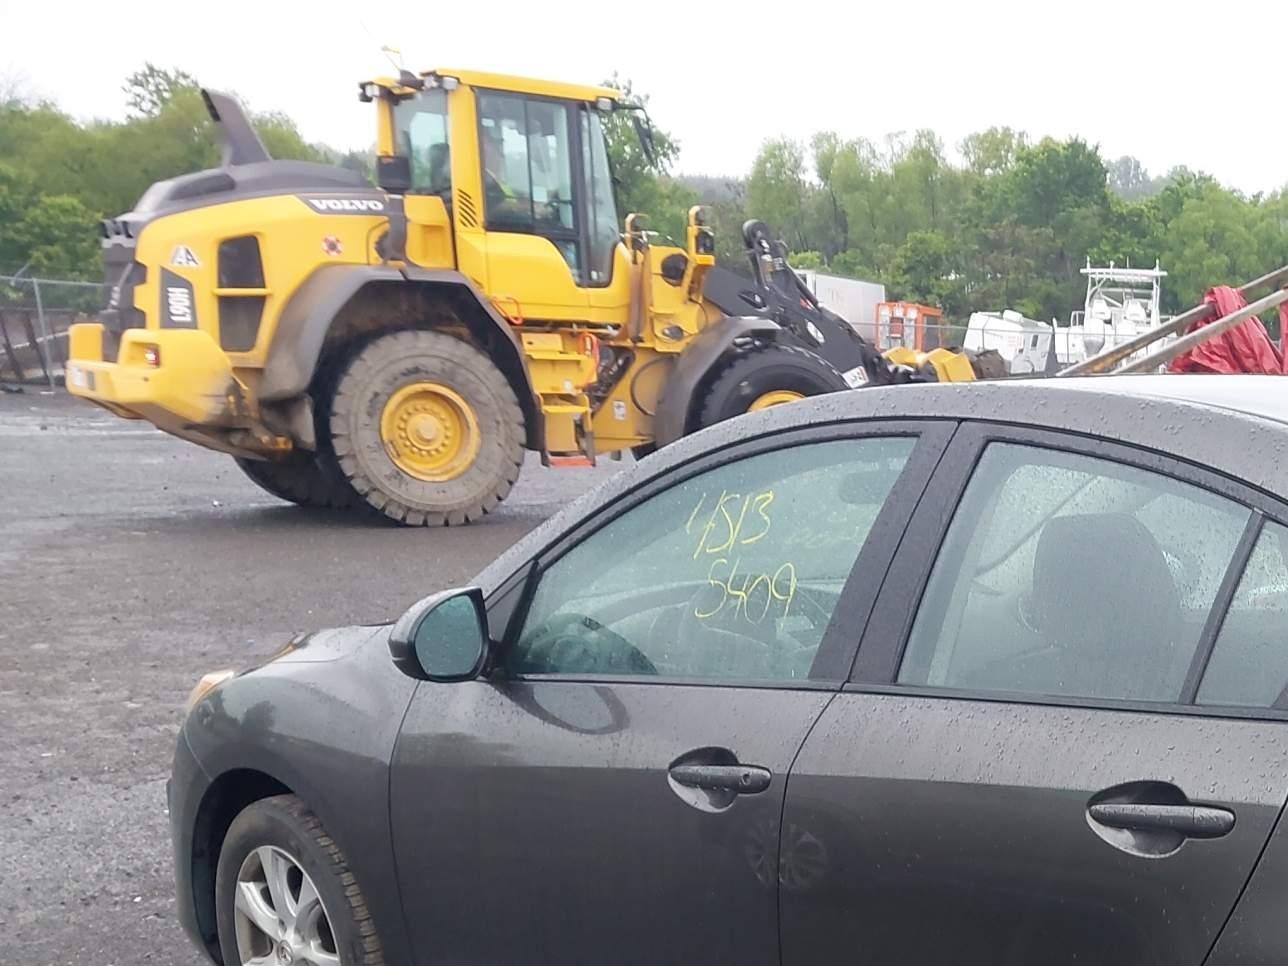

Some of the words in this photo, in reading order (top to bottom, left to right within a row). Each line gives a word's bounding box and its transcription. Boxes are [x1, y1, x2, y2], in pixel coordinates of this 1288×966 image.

[308, 199, 385, 211] VOLVO
[166, 287, 192, 322] L90H
[694, 556, 797, 632] 5409
